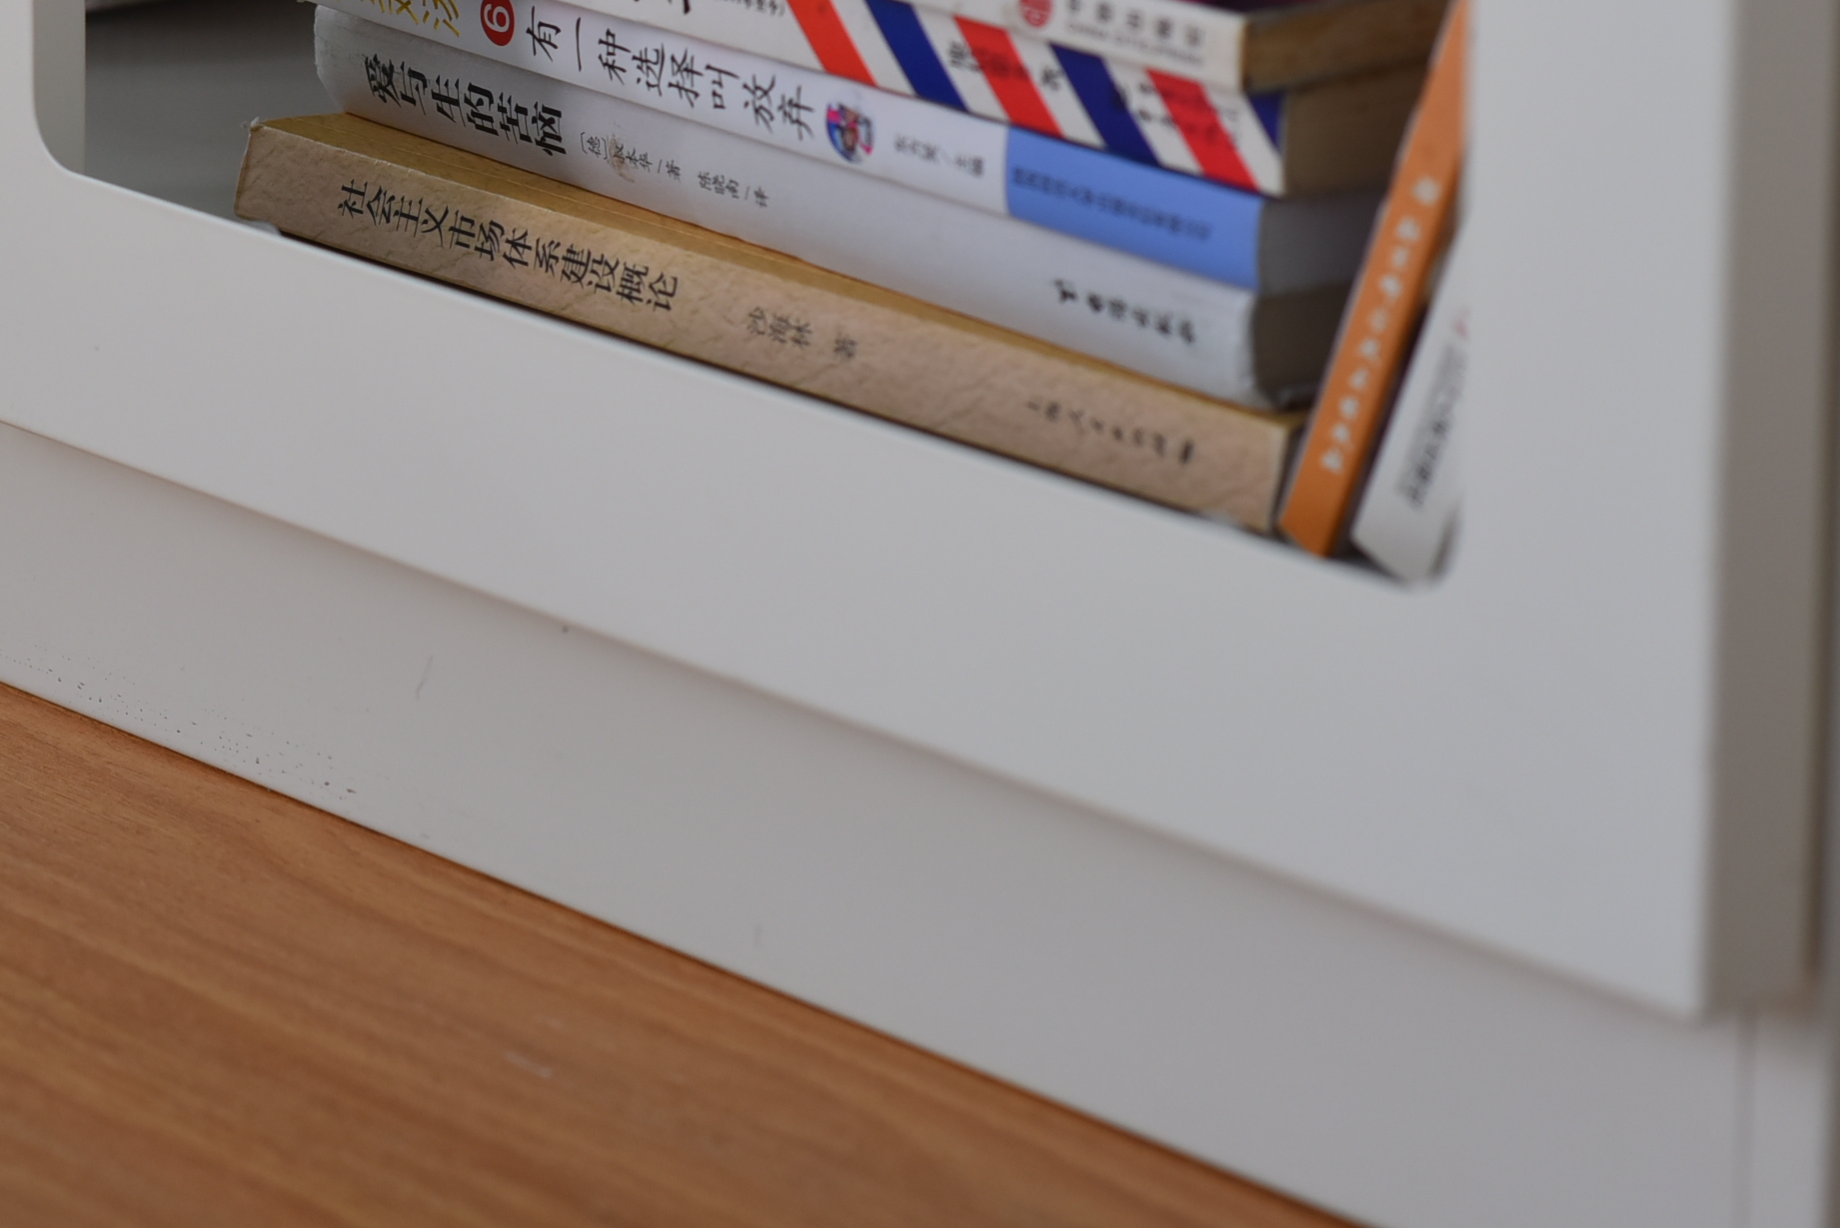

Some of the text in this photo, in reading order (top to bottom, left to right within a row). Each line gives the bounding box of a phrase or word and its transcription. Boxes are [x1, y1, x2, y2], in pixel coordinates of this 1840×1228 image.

[364, 52, 568, 157] 爱与生的苦恼
[524, 5, 815, 142] 有一种选择叫放弃
[338, 177, 680, 313] 社会主义市场体系建设概论
